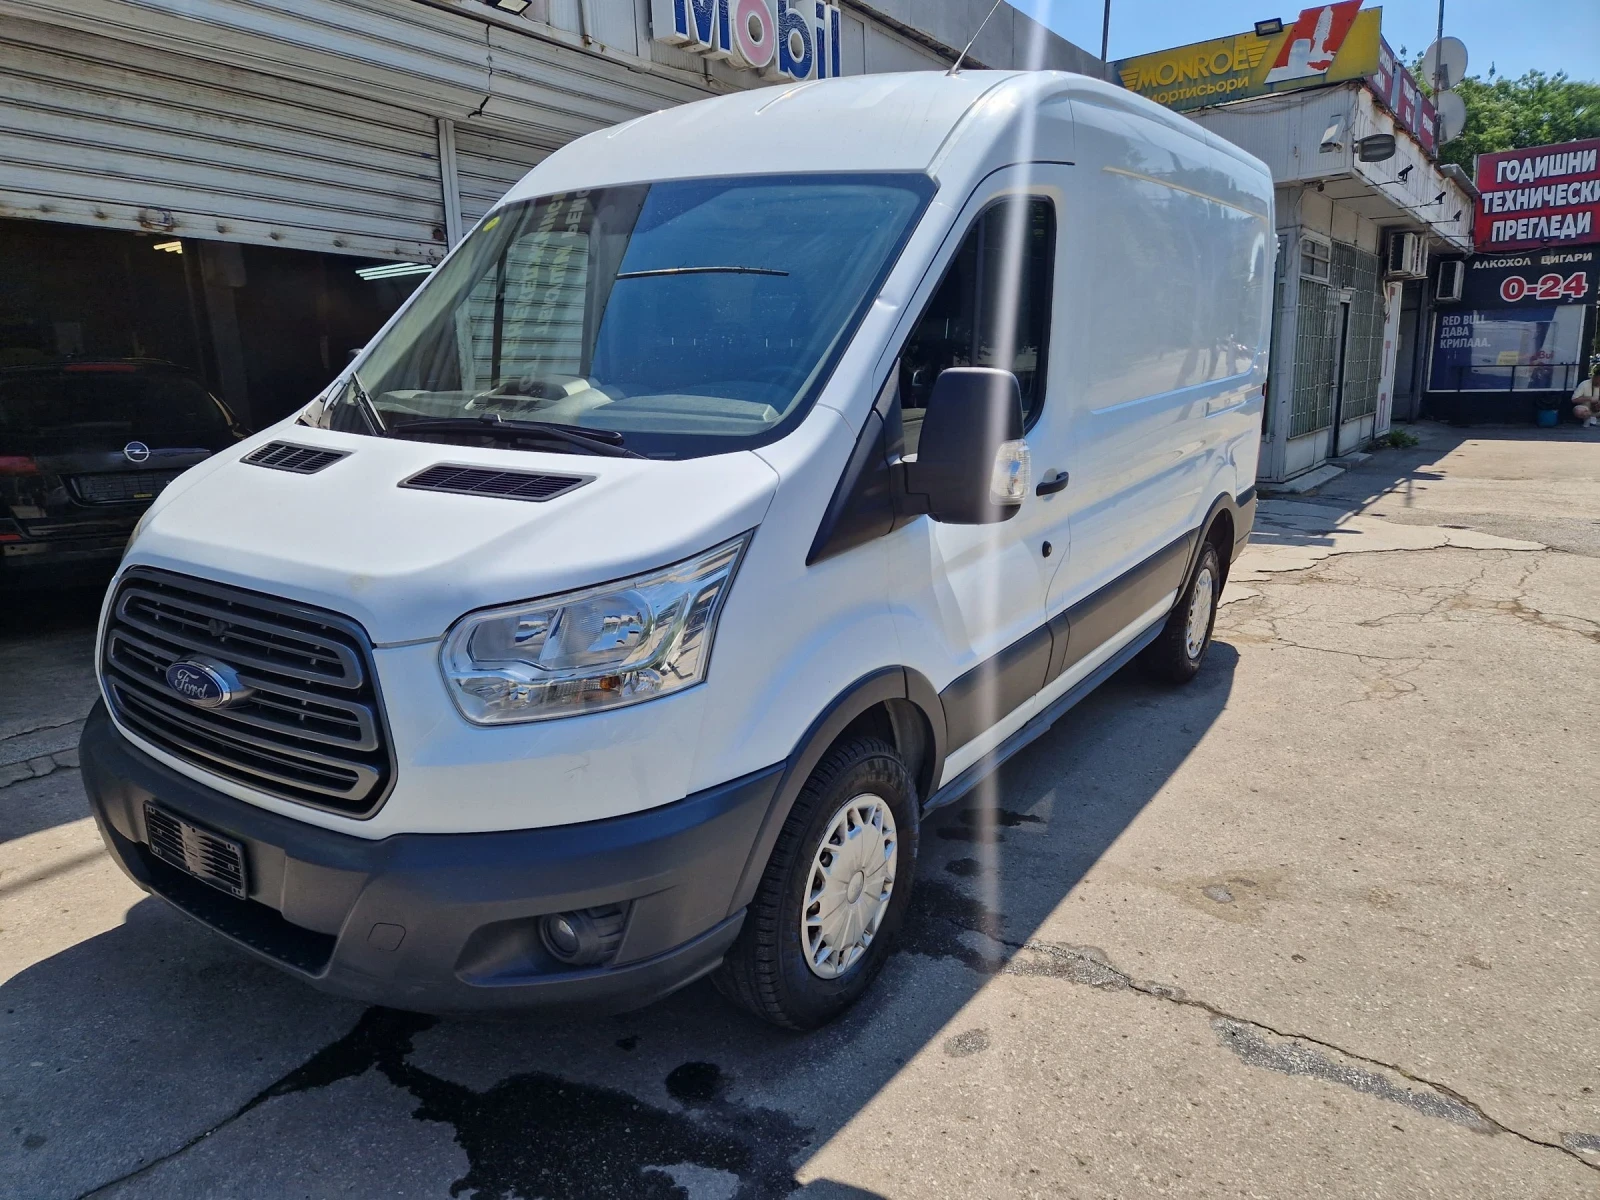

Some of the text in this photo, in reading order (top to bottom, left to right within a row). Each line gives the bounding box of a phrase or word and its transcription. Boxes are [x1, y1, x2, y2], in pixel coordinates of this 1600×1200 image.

[1136, 45, 1250, 91] MONROE
[1496, 149, 1597, 184] ГОДИШНИ
[1491, 211, 1592, 242] ПРЕГЛЕДИ
[1473, 252, 1592, 270] АЛКОХОЛ ЦИГАРИ
[1500, 272, 1589, 302] 0-24
[1440, 326, 1470, 338] ДАВА
[1442, 314, 1485, 326] RED BULL
[1440, 337, 1491, 349] КРИЛААА.
[174, 668, 208, 700] Ford
